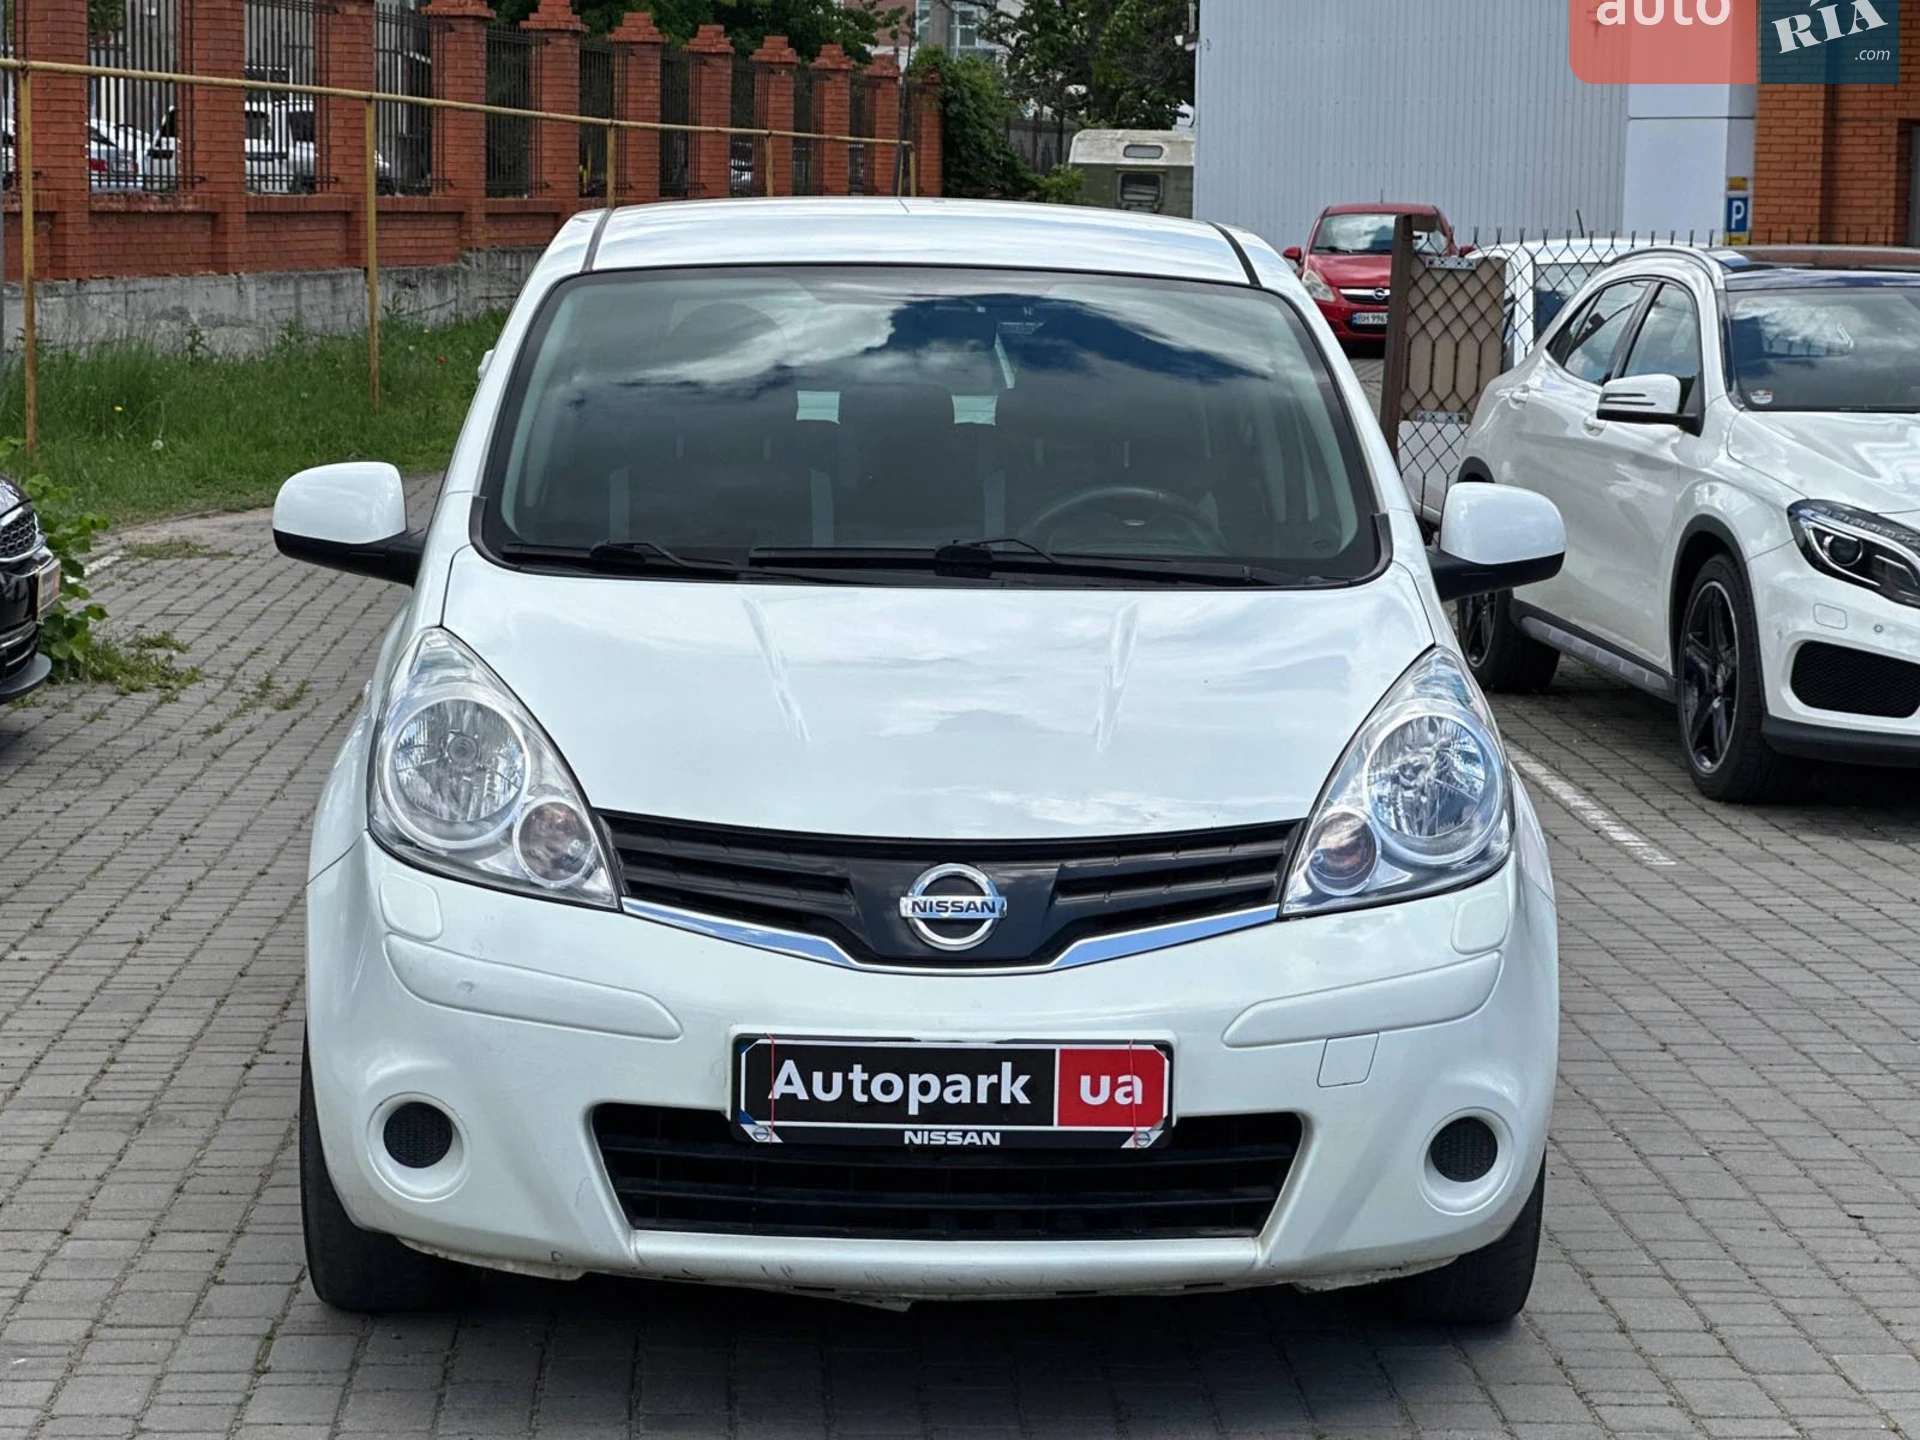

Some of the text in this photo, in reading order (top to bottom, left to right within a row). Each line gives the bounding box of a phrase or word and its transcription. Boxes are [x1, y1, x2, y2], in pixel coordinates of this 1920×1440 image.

[1730, 199, 1746, 229] P
[911, 900, 996, 914] NISSAN
[768, 1059, 1144, 1116] Autopark ua
[903, 1129, 1001, 1146] NISSAN
